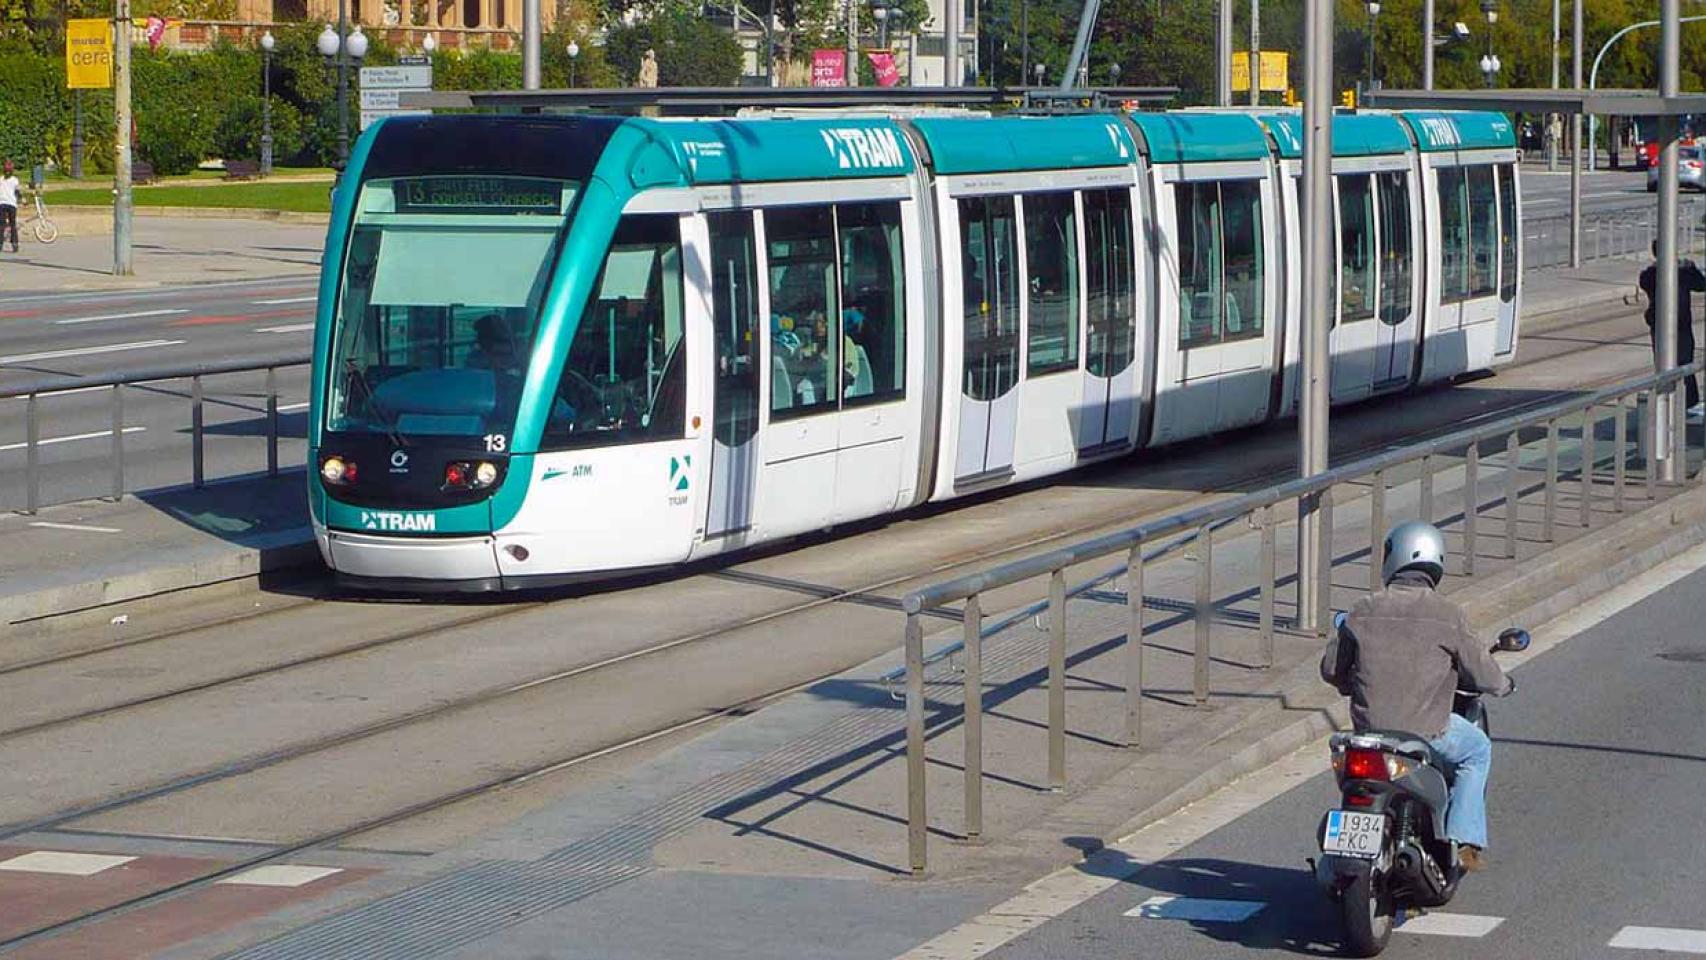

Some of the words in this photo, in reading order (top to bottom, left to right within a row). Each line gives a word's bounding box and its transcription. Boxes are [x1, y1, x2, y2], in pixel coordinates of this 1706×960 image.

[840, 128, 904, 168] TRAM
[483, 434, 506, 451] 13
[571, 464, 593, 477] ATM
[376, 513, 436, 531] TRAM
[1343, 814, 1379, 833] 1934
[1337, 832, 1368, 850] FKC
